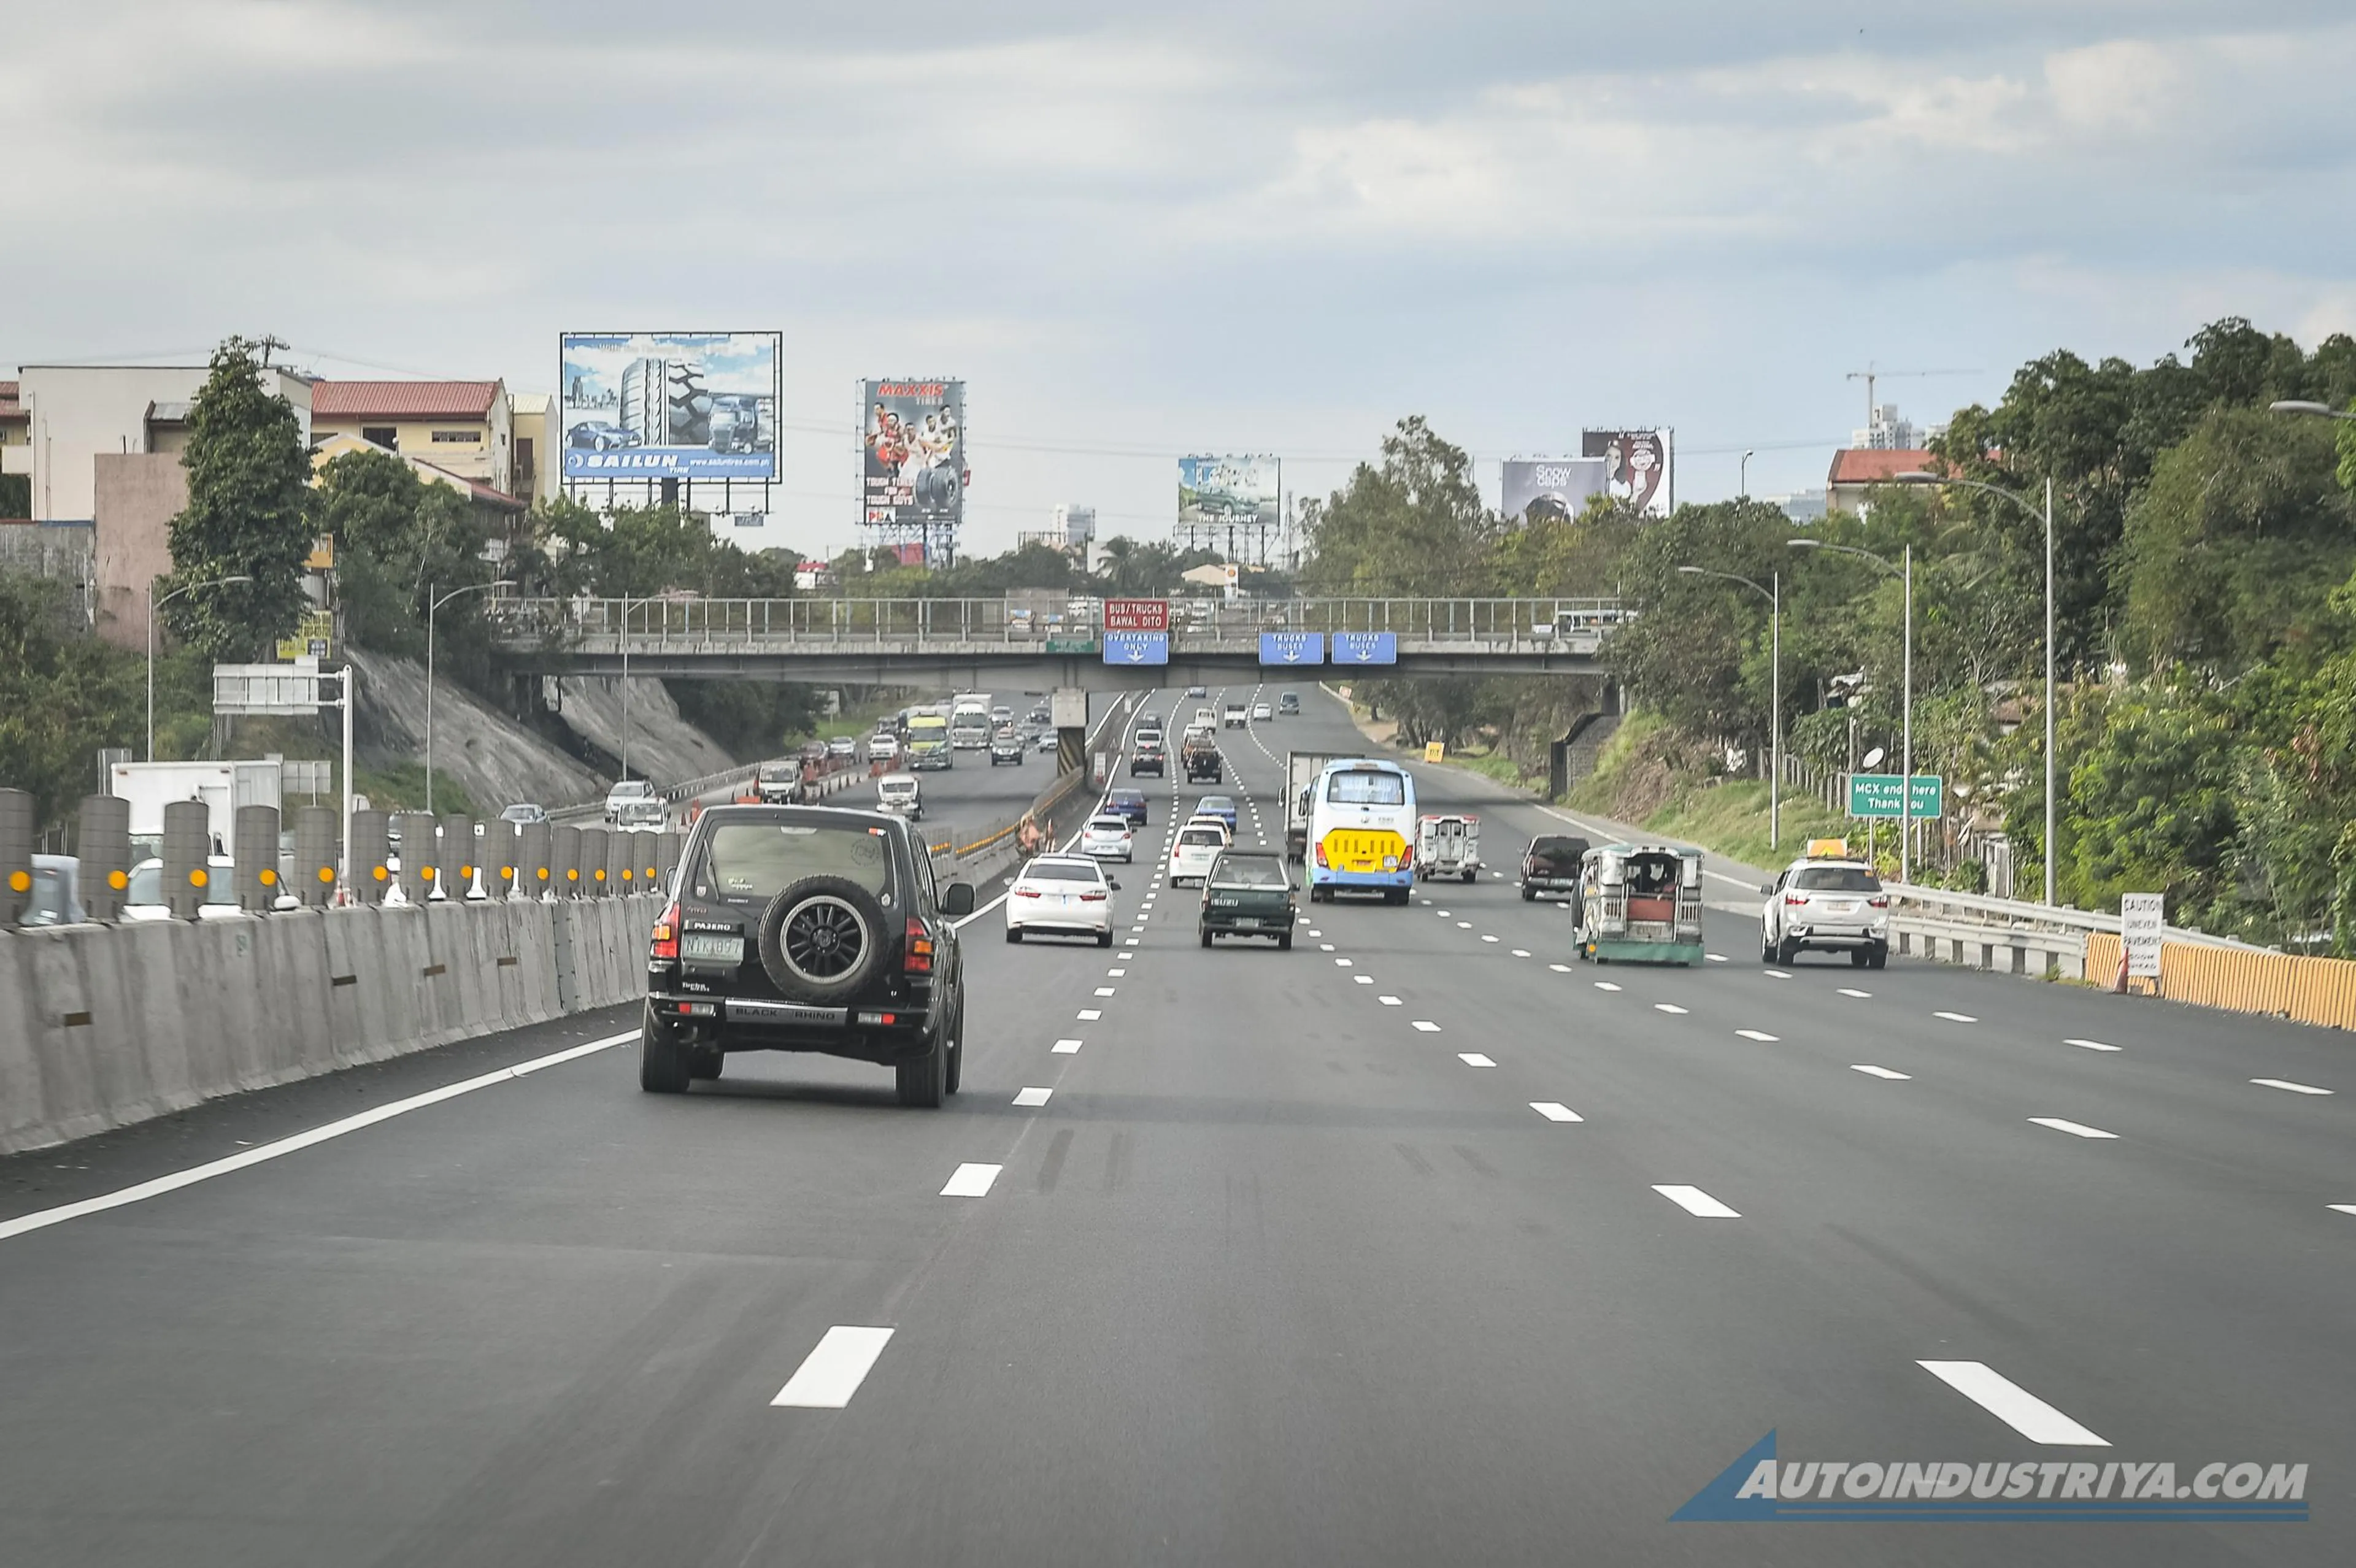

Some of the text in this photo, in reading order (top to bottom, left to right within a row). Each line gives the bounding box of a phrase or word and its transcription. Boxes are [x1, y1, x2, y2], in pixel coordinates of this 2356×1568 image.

[877, 383, 944, 397] MAXXIS
[587, 455, 678, 467] SAILUN
[1218, 514, 1258, 523] JOURNEY
[1109, 604, 1163, 614] BUS/TRUCKS
[1111, 616, 1162, 626] BAWAL DITO
[1855, 783, 1936, 796] MCX end here
[1868, 798, 1924, 810] Thank ou
[2125, 899, 2163, 912] CAUTION
[694, 922, 731, 931] PAJERO
[736, 1008, 836, 1020] BLACK RHINO
